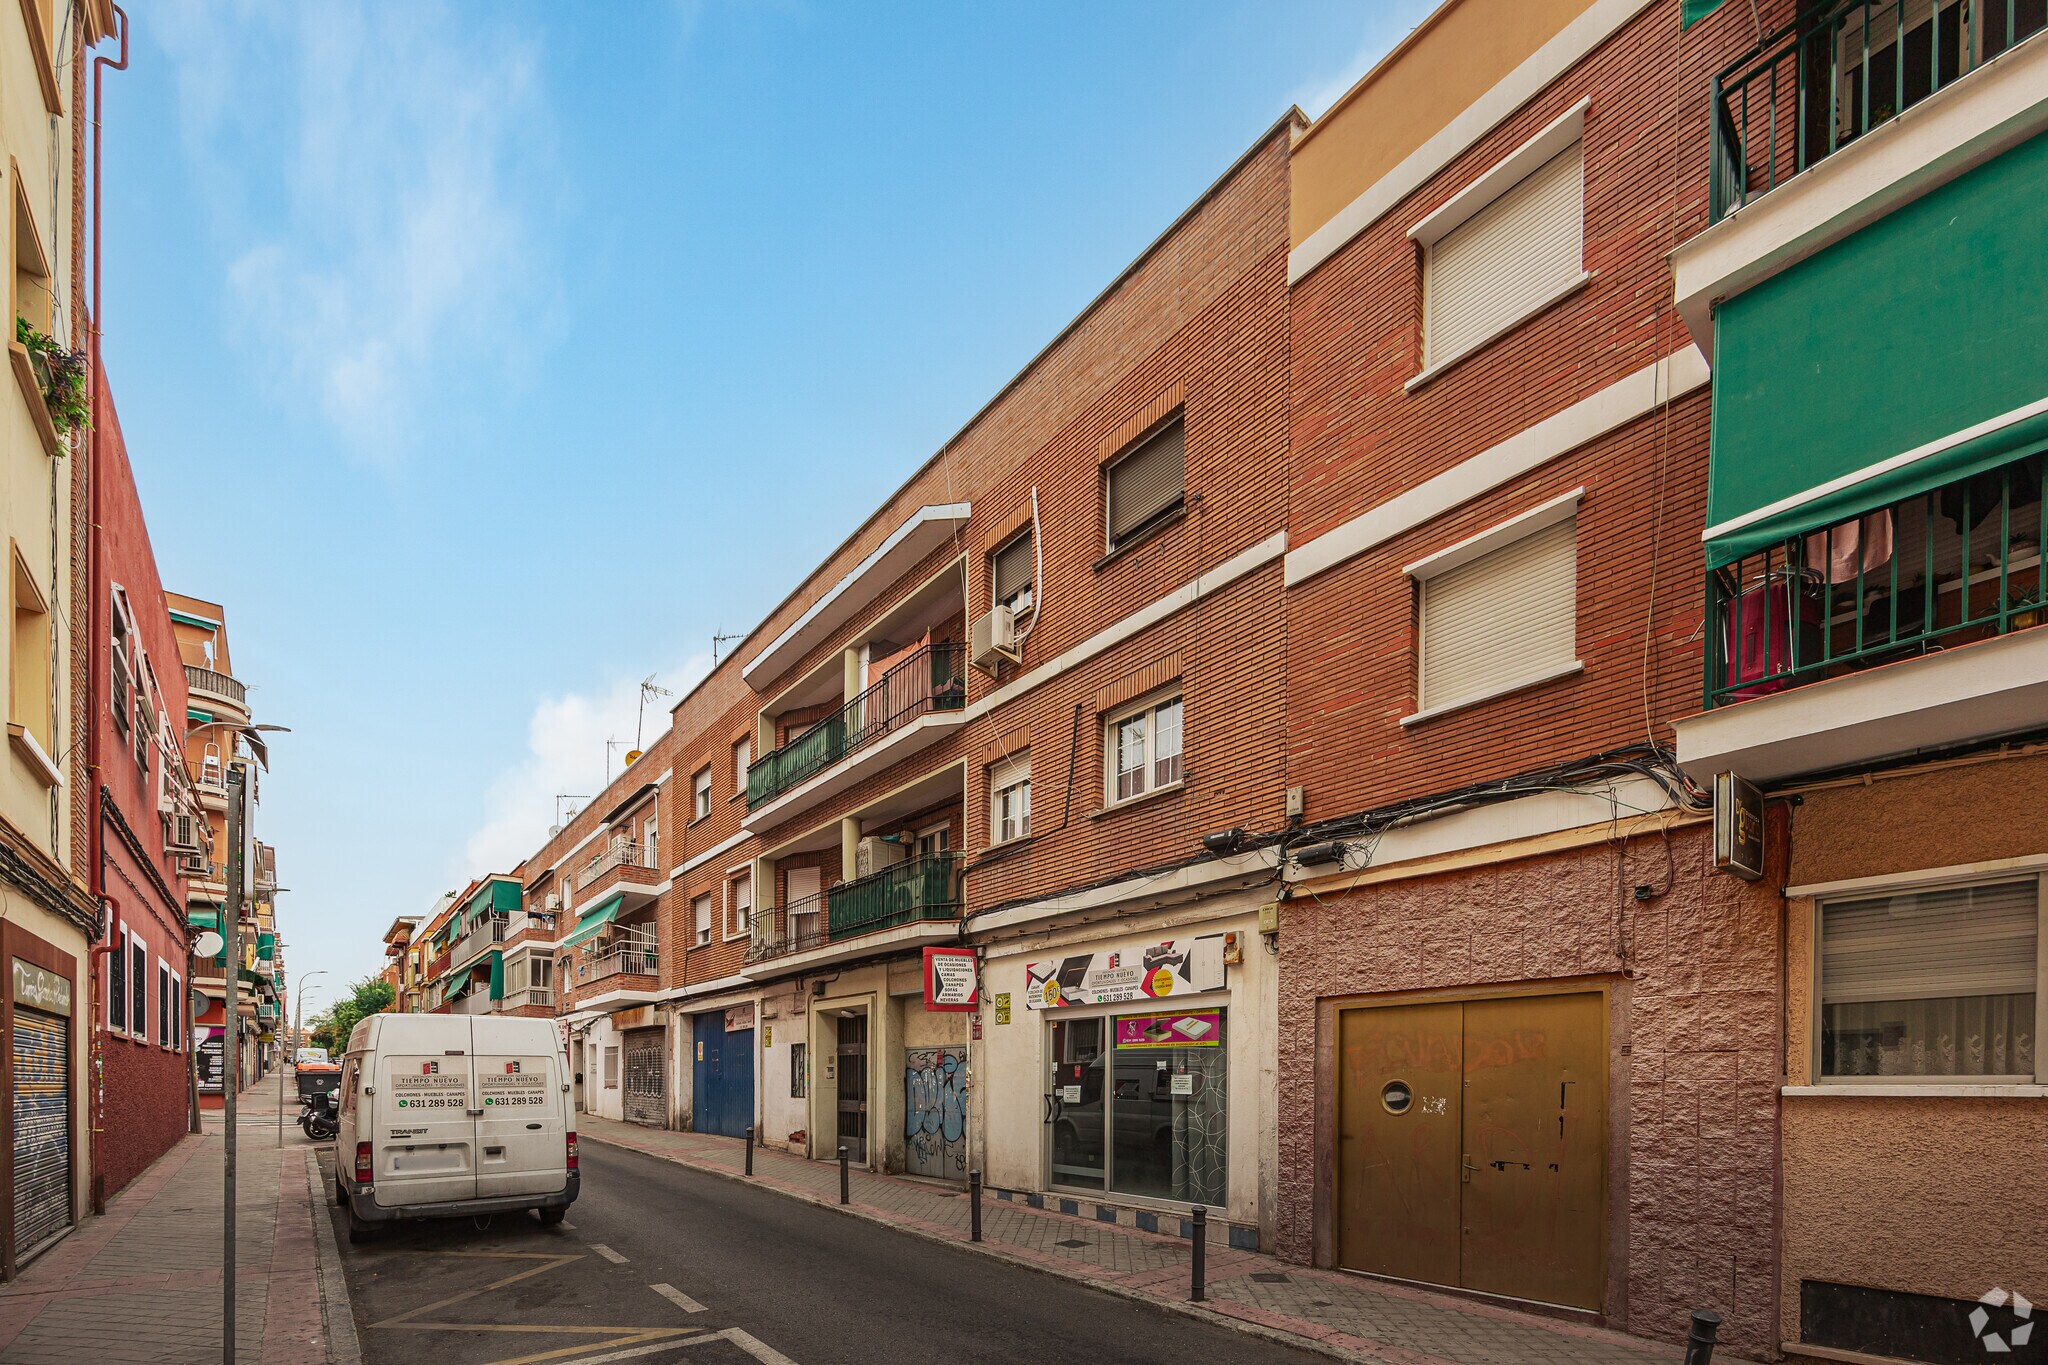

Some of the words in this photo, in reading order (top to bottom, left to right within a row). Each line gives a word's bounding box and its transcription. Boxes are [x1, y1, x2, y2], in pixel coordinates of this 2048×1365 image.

[1095, 972, 1115, 981] TIEMPO
[1117, 970, 1134, 979] NUEVO
[1103, 994, 1112, 1002] 631
[1113, 993, 1123, 1001] 289
[1123, 992, 1133, 1000] 528
[409, 1099, 426, 1108] 631
[428, 1099, 445, 1108] 289
[447, 1098, 464, 1107] 528
[495, 1097, 510, 1106] 631
[511, 1097, 527, 1105] 289
[528, 1096, 544, 1105] 528
